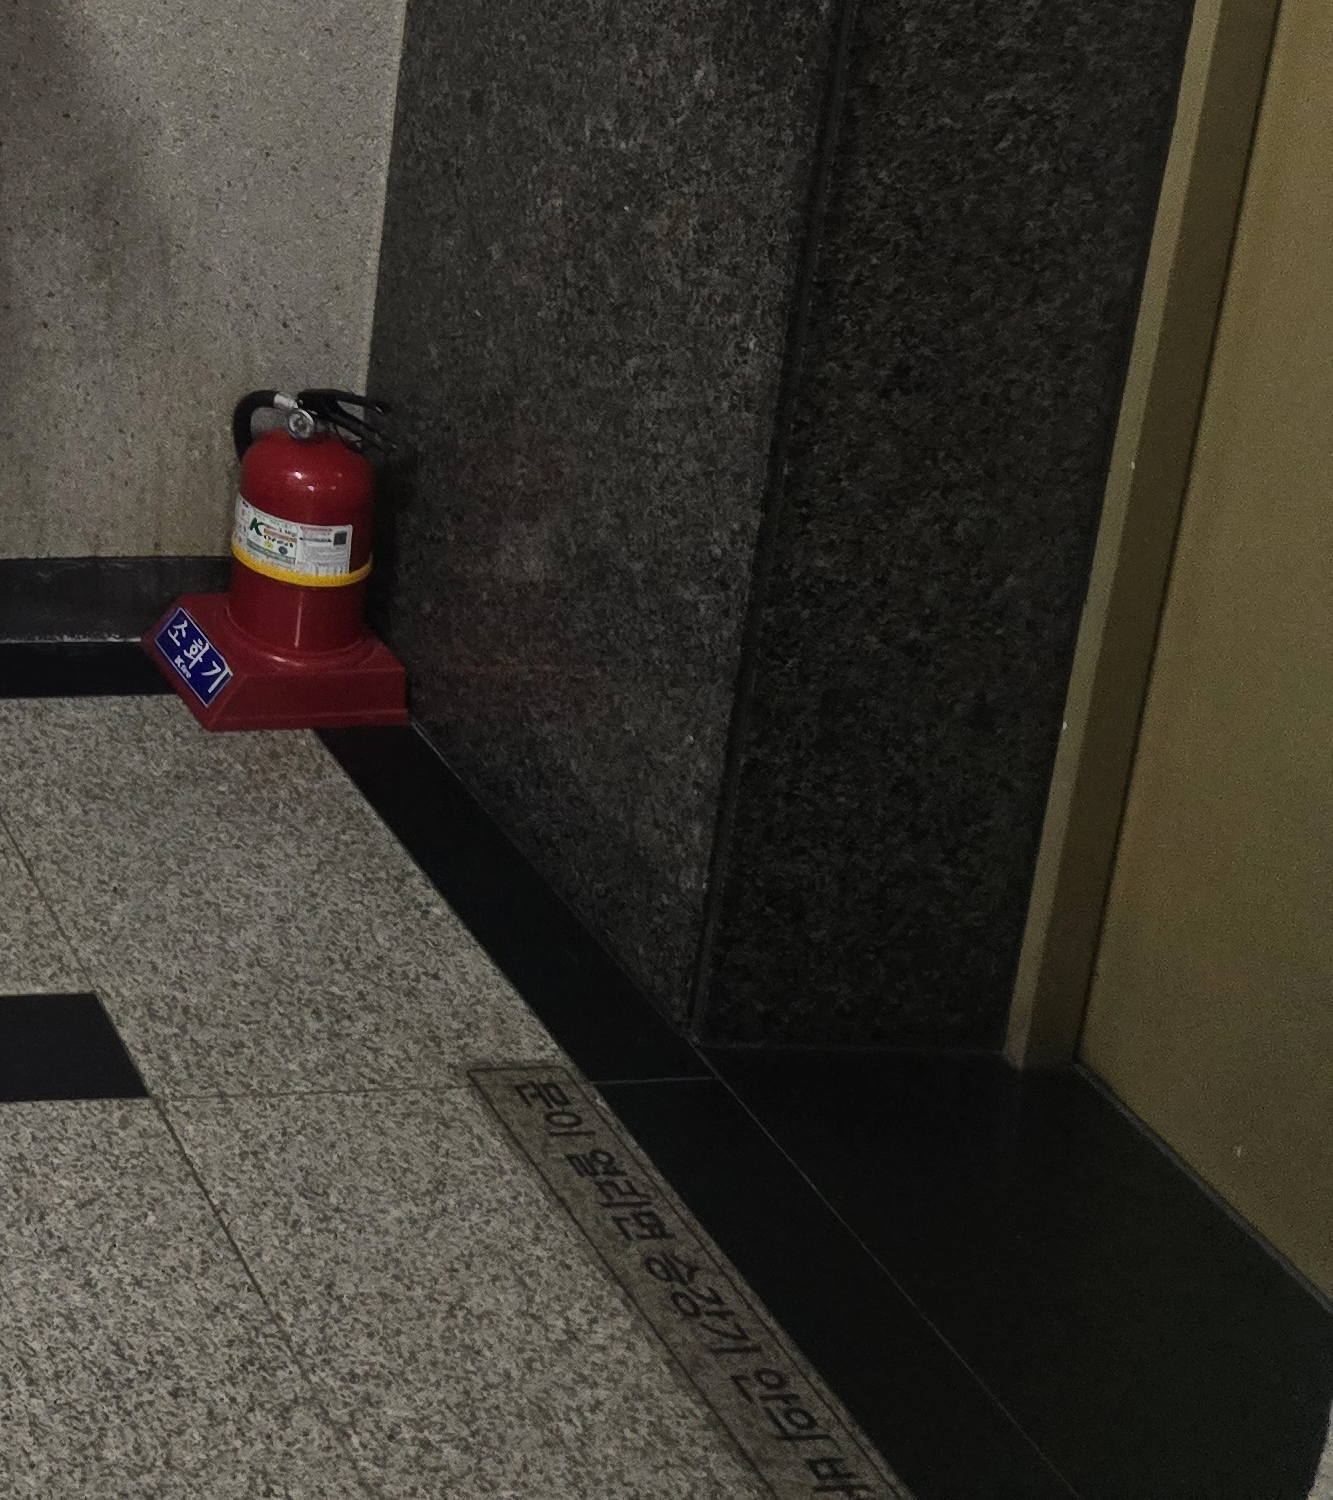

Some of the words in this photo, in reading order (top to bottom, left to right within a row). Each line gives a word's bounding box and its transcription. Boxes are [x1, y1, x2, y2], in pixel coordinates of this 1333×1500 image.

[167, 619, 230, 694] 소화기
[513, 1079, 597, 1137] 문이
[564, 1146, 677, 1241] 열리면
[644, 1251, 763, 1356] 승강기
[730, 1367, 833, 1443] 안의
